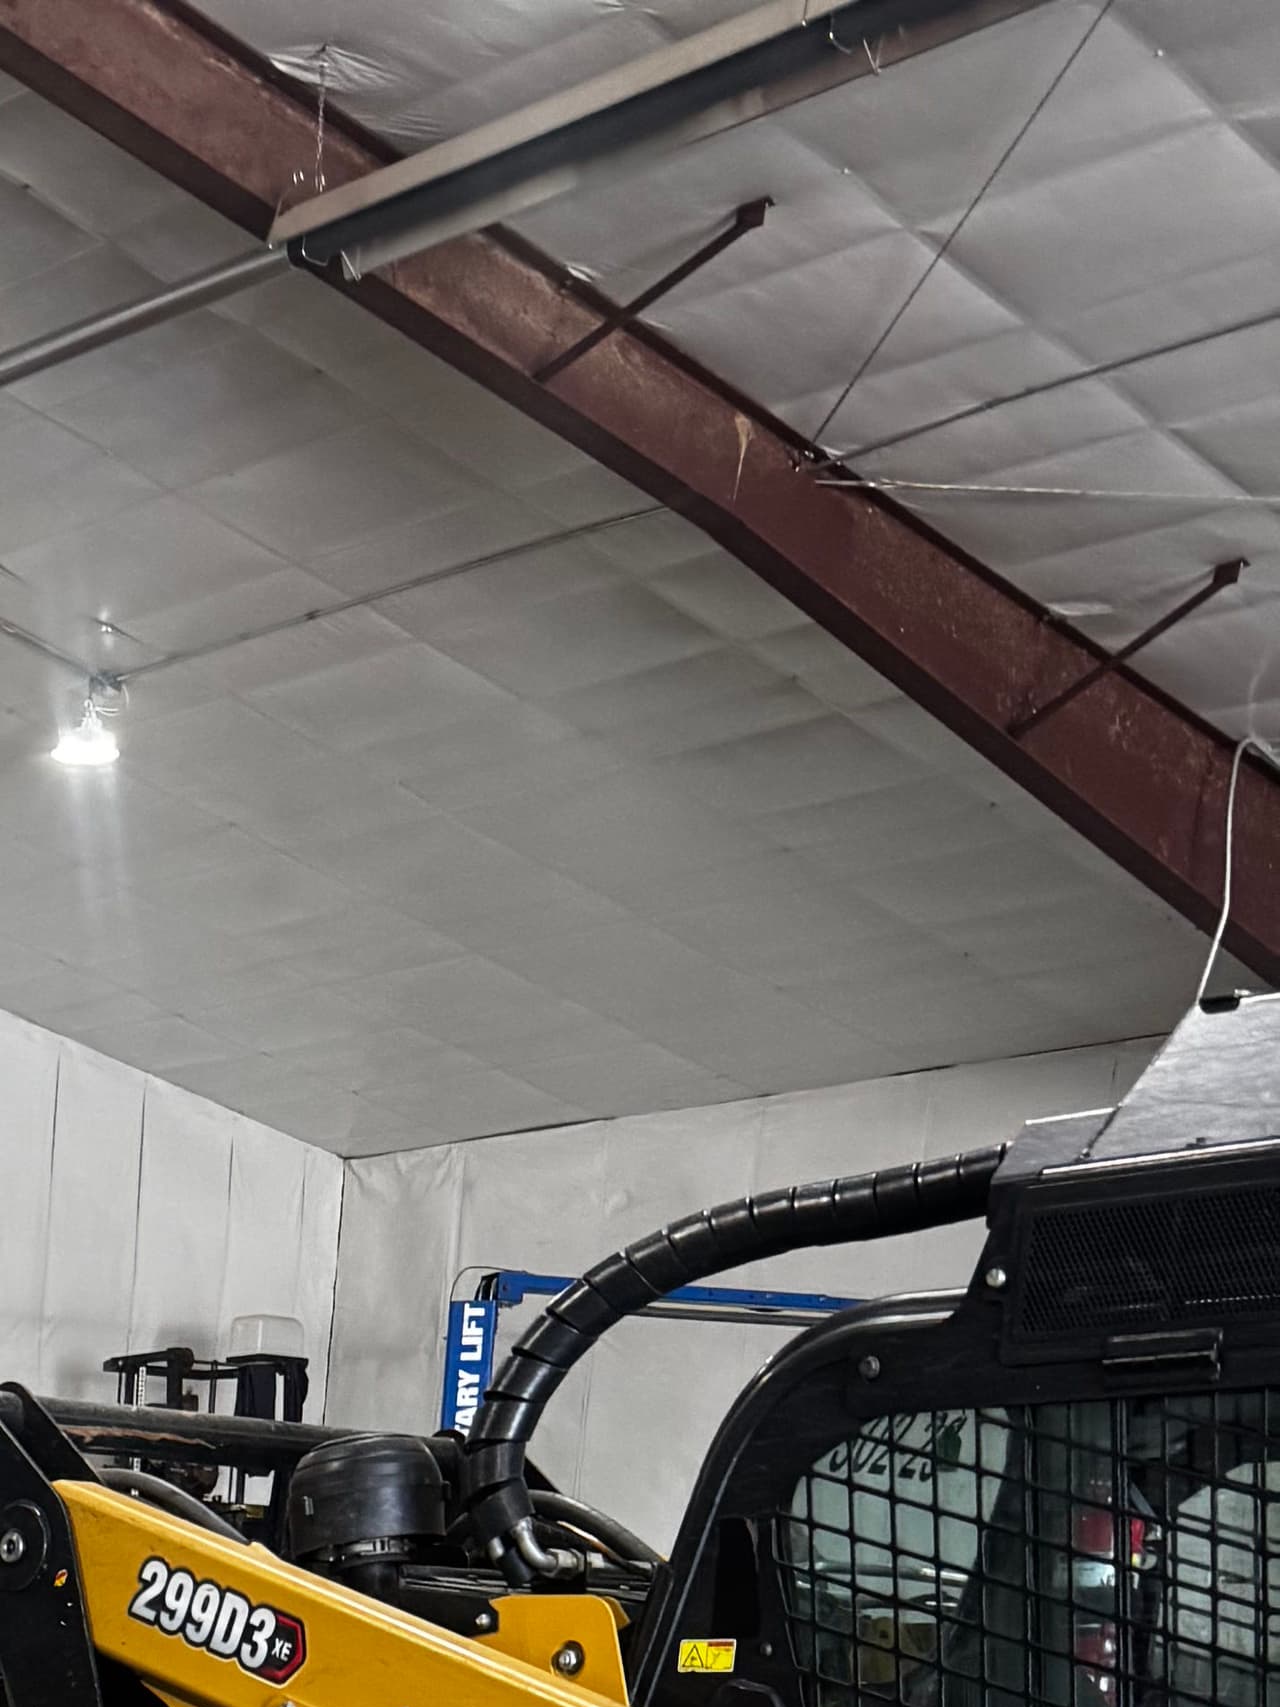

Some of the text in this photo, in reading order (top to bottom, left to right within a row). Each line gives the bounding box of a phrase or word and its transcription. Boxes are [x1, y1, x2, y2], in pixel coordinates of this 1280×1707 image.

[454, 1303, 486, 1437] TARY LIFT
[130, 1560, 292, 1668] 299D3 XE
